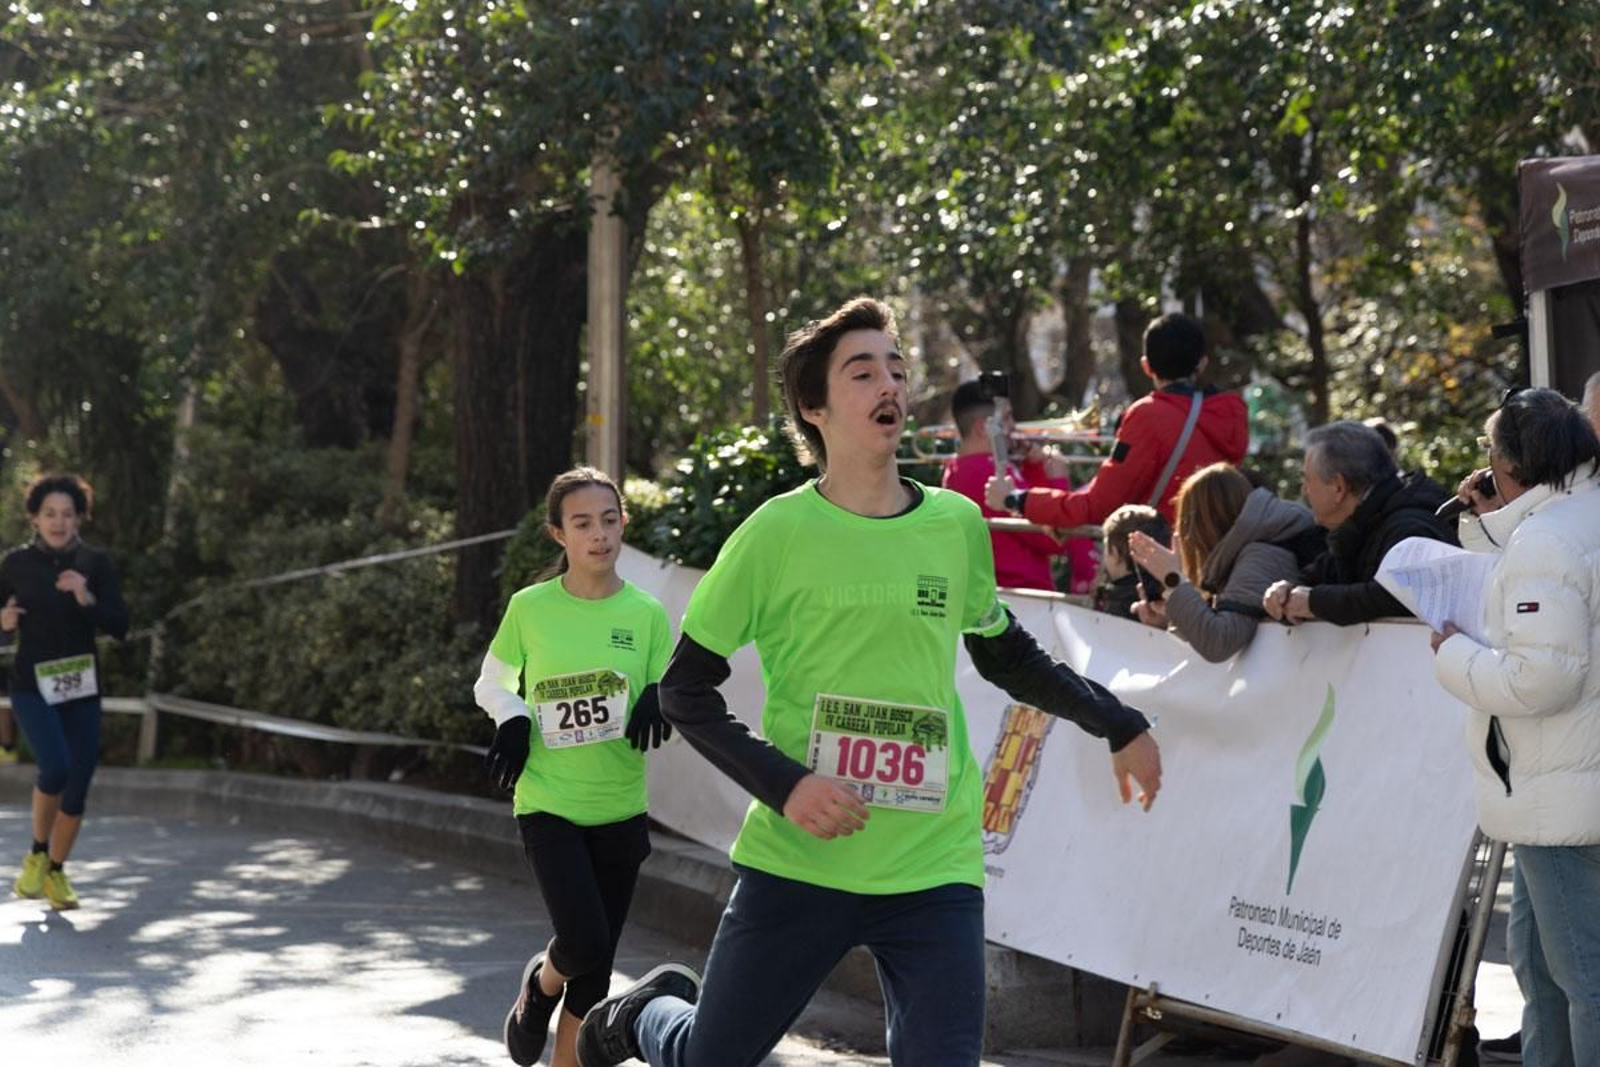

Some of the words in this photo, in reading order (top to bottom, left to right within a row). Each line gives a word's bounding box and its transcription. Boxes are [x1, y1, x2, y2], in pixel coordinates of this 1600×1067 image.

[556, 696, 610, 730] 265
[835, 715, 870, 733] CARRERA
[872, 720, 906, 736] POPULAR
[843, 703, 861, 717] SAN
[863, 704, 888, 720] JUAN
[889, 707, 914, 723] BOSCO
[836, 736, 926, 787] 1036
[1229, 895, 1277, 925] Patronato
[1278, 905, 1327, 939] Municipal
[1328, 918, 1342, 940] de
[1237, 926, 1282, 956] Deportes
[1282, 939, 1296, 960] de
